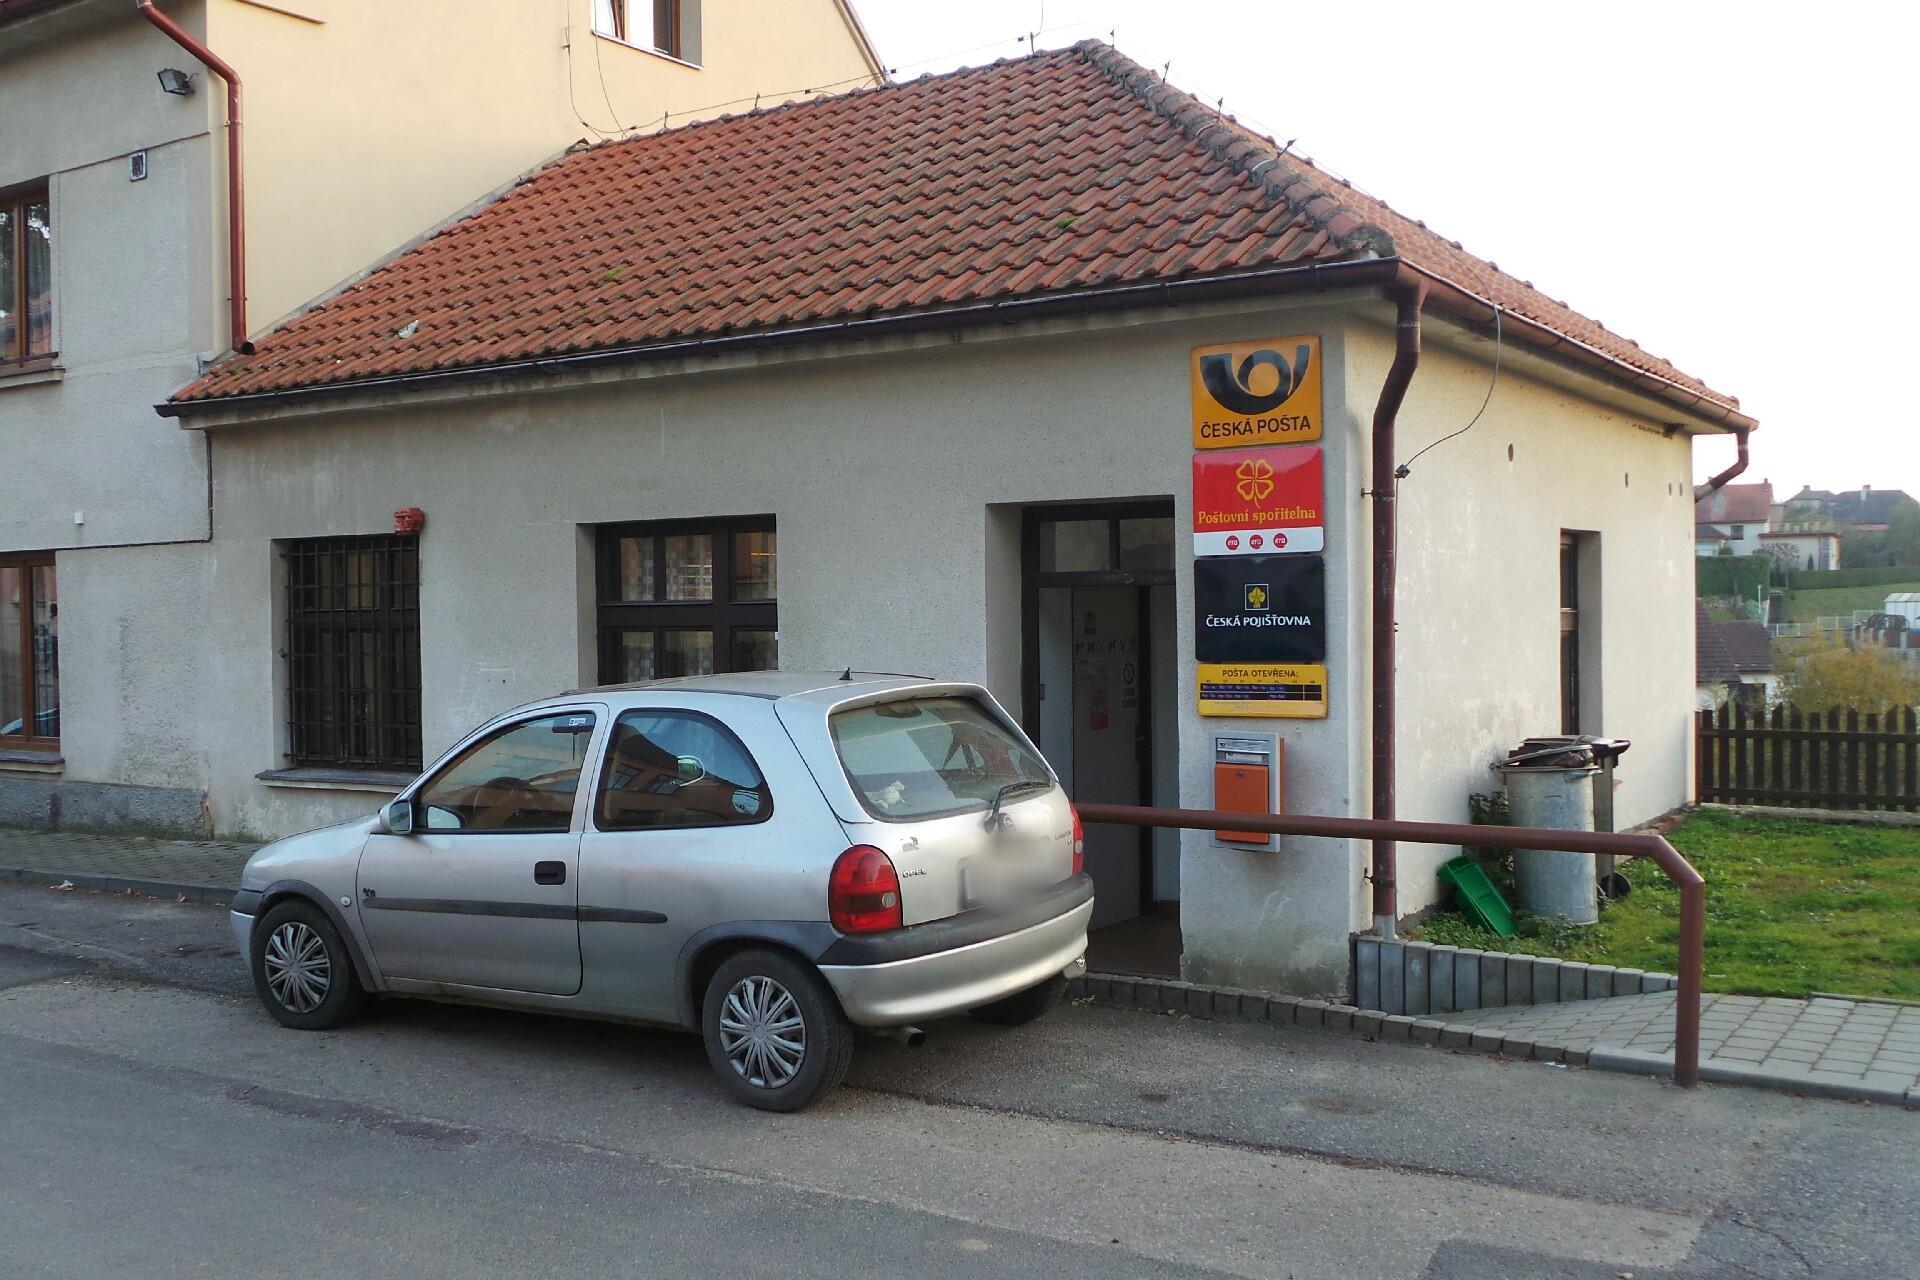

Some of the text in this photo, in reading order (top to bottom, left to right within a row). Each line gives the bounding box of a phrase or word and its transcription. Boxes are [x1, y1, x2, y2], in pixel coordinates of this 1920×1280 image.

[1200, 415, 1311, 439] ČESKÁ POŠTA
[1198, 506, 1316, 524] Poštovní spořitelna
[1206, 614, 1311, 627] ČESKÁ POJIŠŤOVNA
[1222, 668, 1299, 678] POŠTA OTEVŘENA:
[902, 868, 927, 878] OPEL
